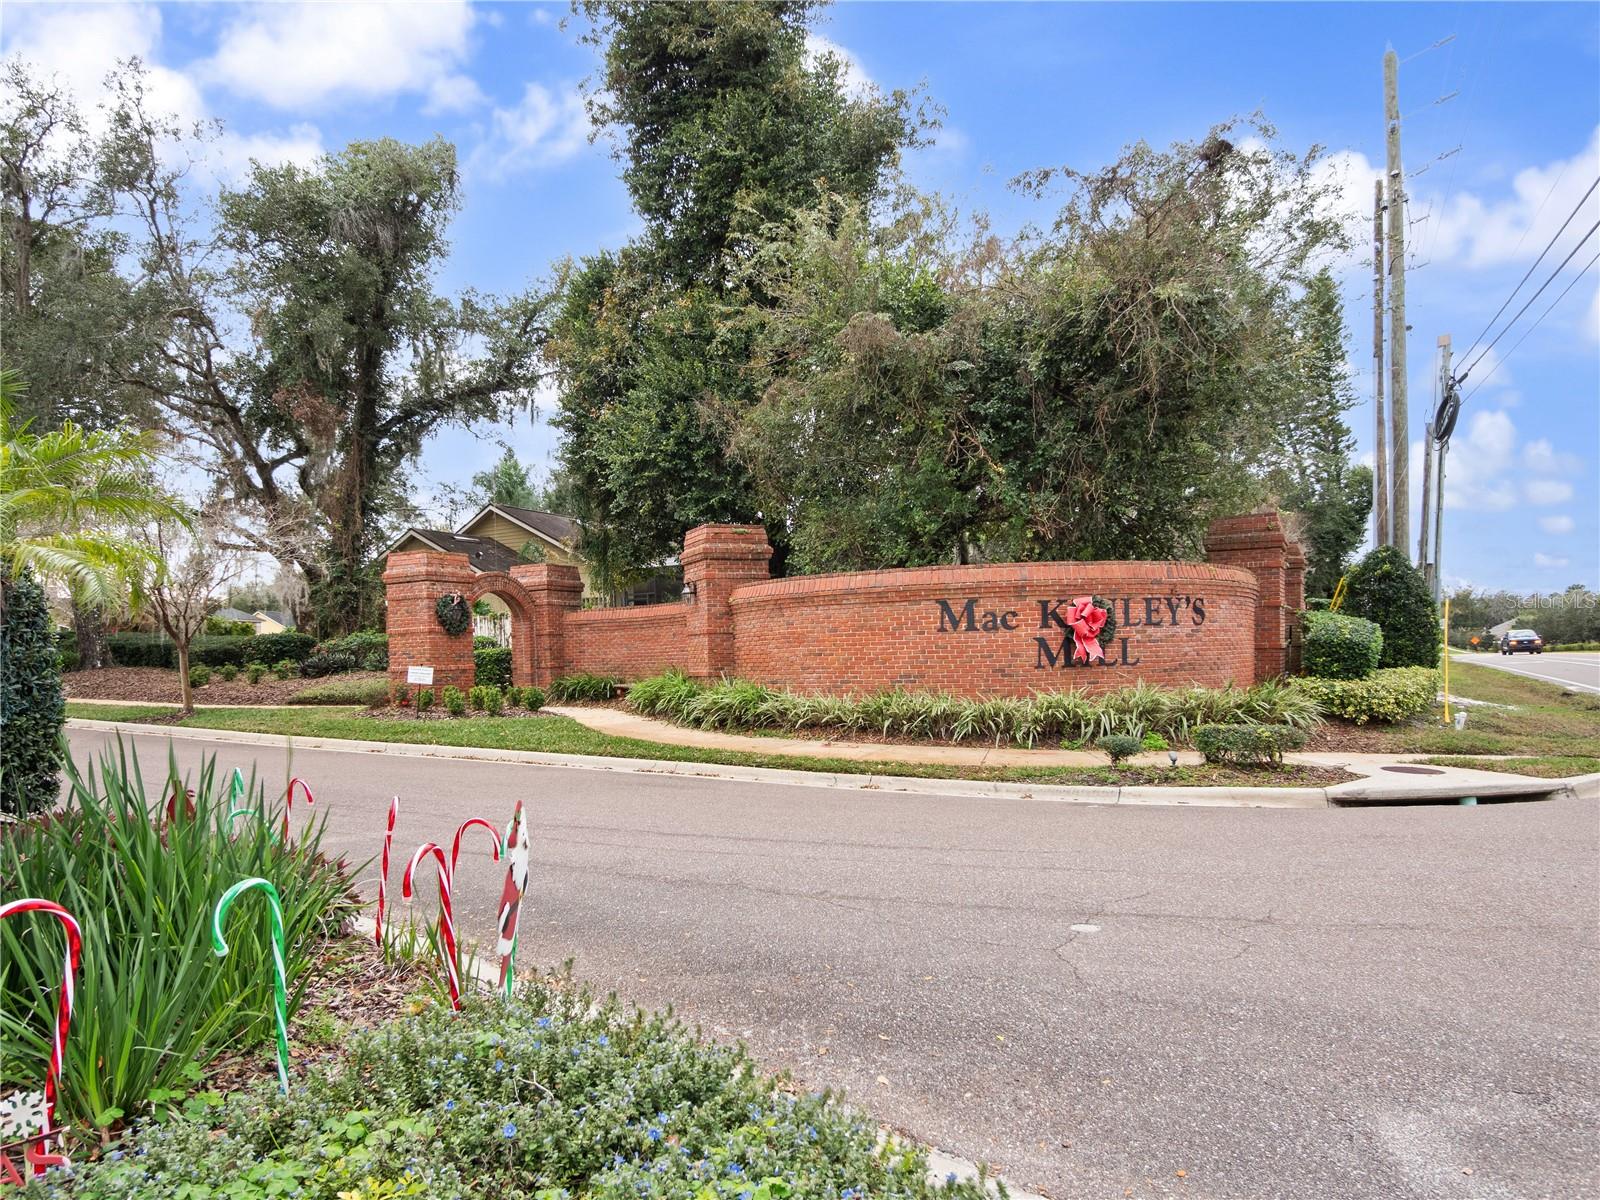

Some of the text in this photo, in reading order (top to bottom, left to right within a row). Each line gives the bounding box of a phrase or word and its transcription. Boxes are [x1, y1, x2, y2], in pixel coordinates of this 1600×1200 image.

[936, 595, 1206, 633] Mac KLEY'S
[1033, 637, 1141, 669] MLL
